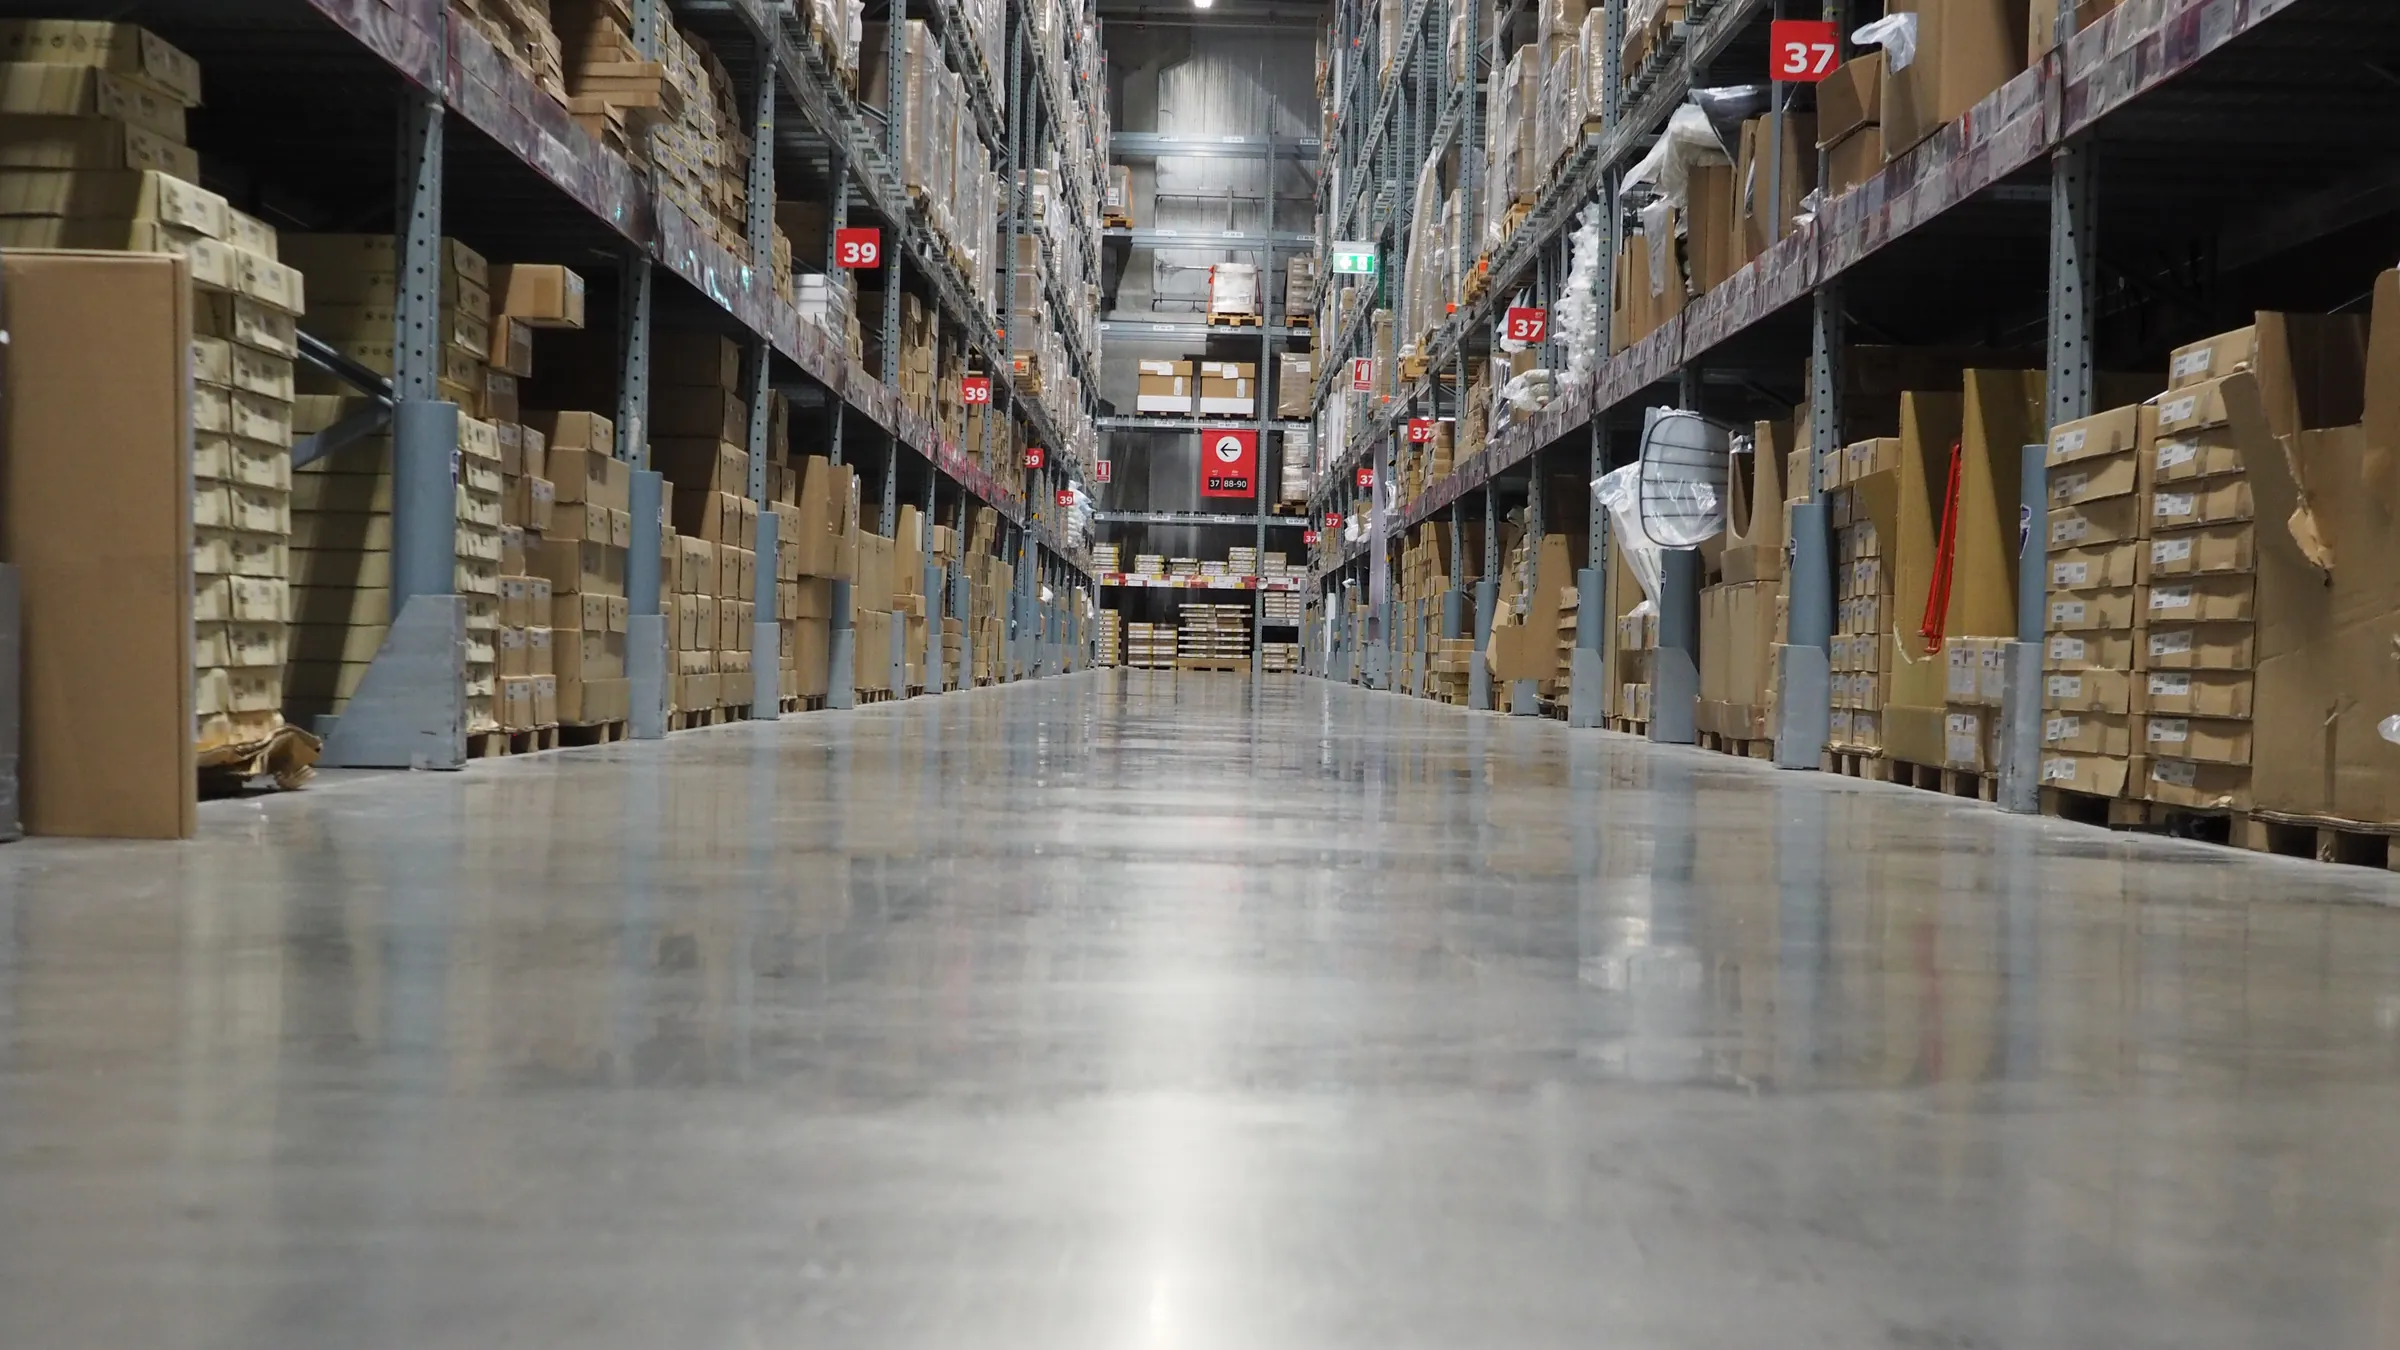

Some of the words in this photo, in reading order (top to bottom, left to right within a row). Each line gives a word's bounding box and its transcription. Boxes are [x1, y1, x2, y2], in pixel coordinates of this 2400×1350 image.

[1784, 42, 1835, 74] 37
[844, 242, 877, 263] 39
[1514, 319, 1543, 337] 37
[965, 387, 987, 401] 39
[1413, 427, 1430, 439] 37
[1024, 456, 1039, 465] 39
[1210, 479, 1220, 487] 37
[1224, 480, 1247, 488] 88-90
[1360, 475, 1373, 484] 37
[1060, 496, 1073, 505] 39
[1326, 518, 1338, 526] 37
[1306, 535, 1316, 543] 37
